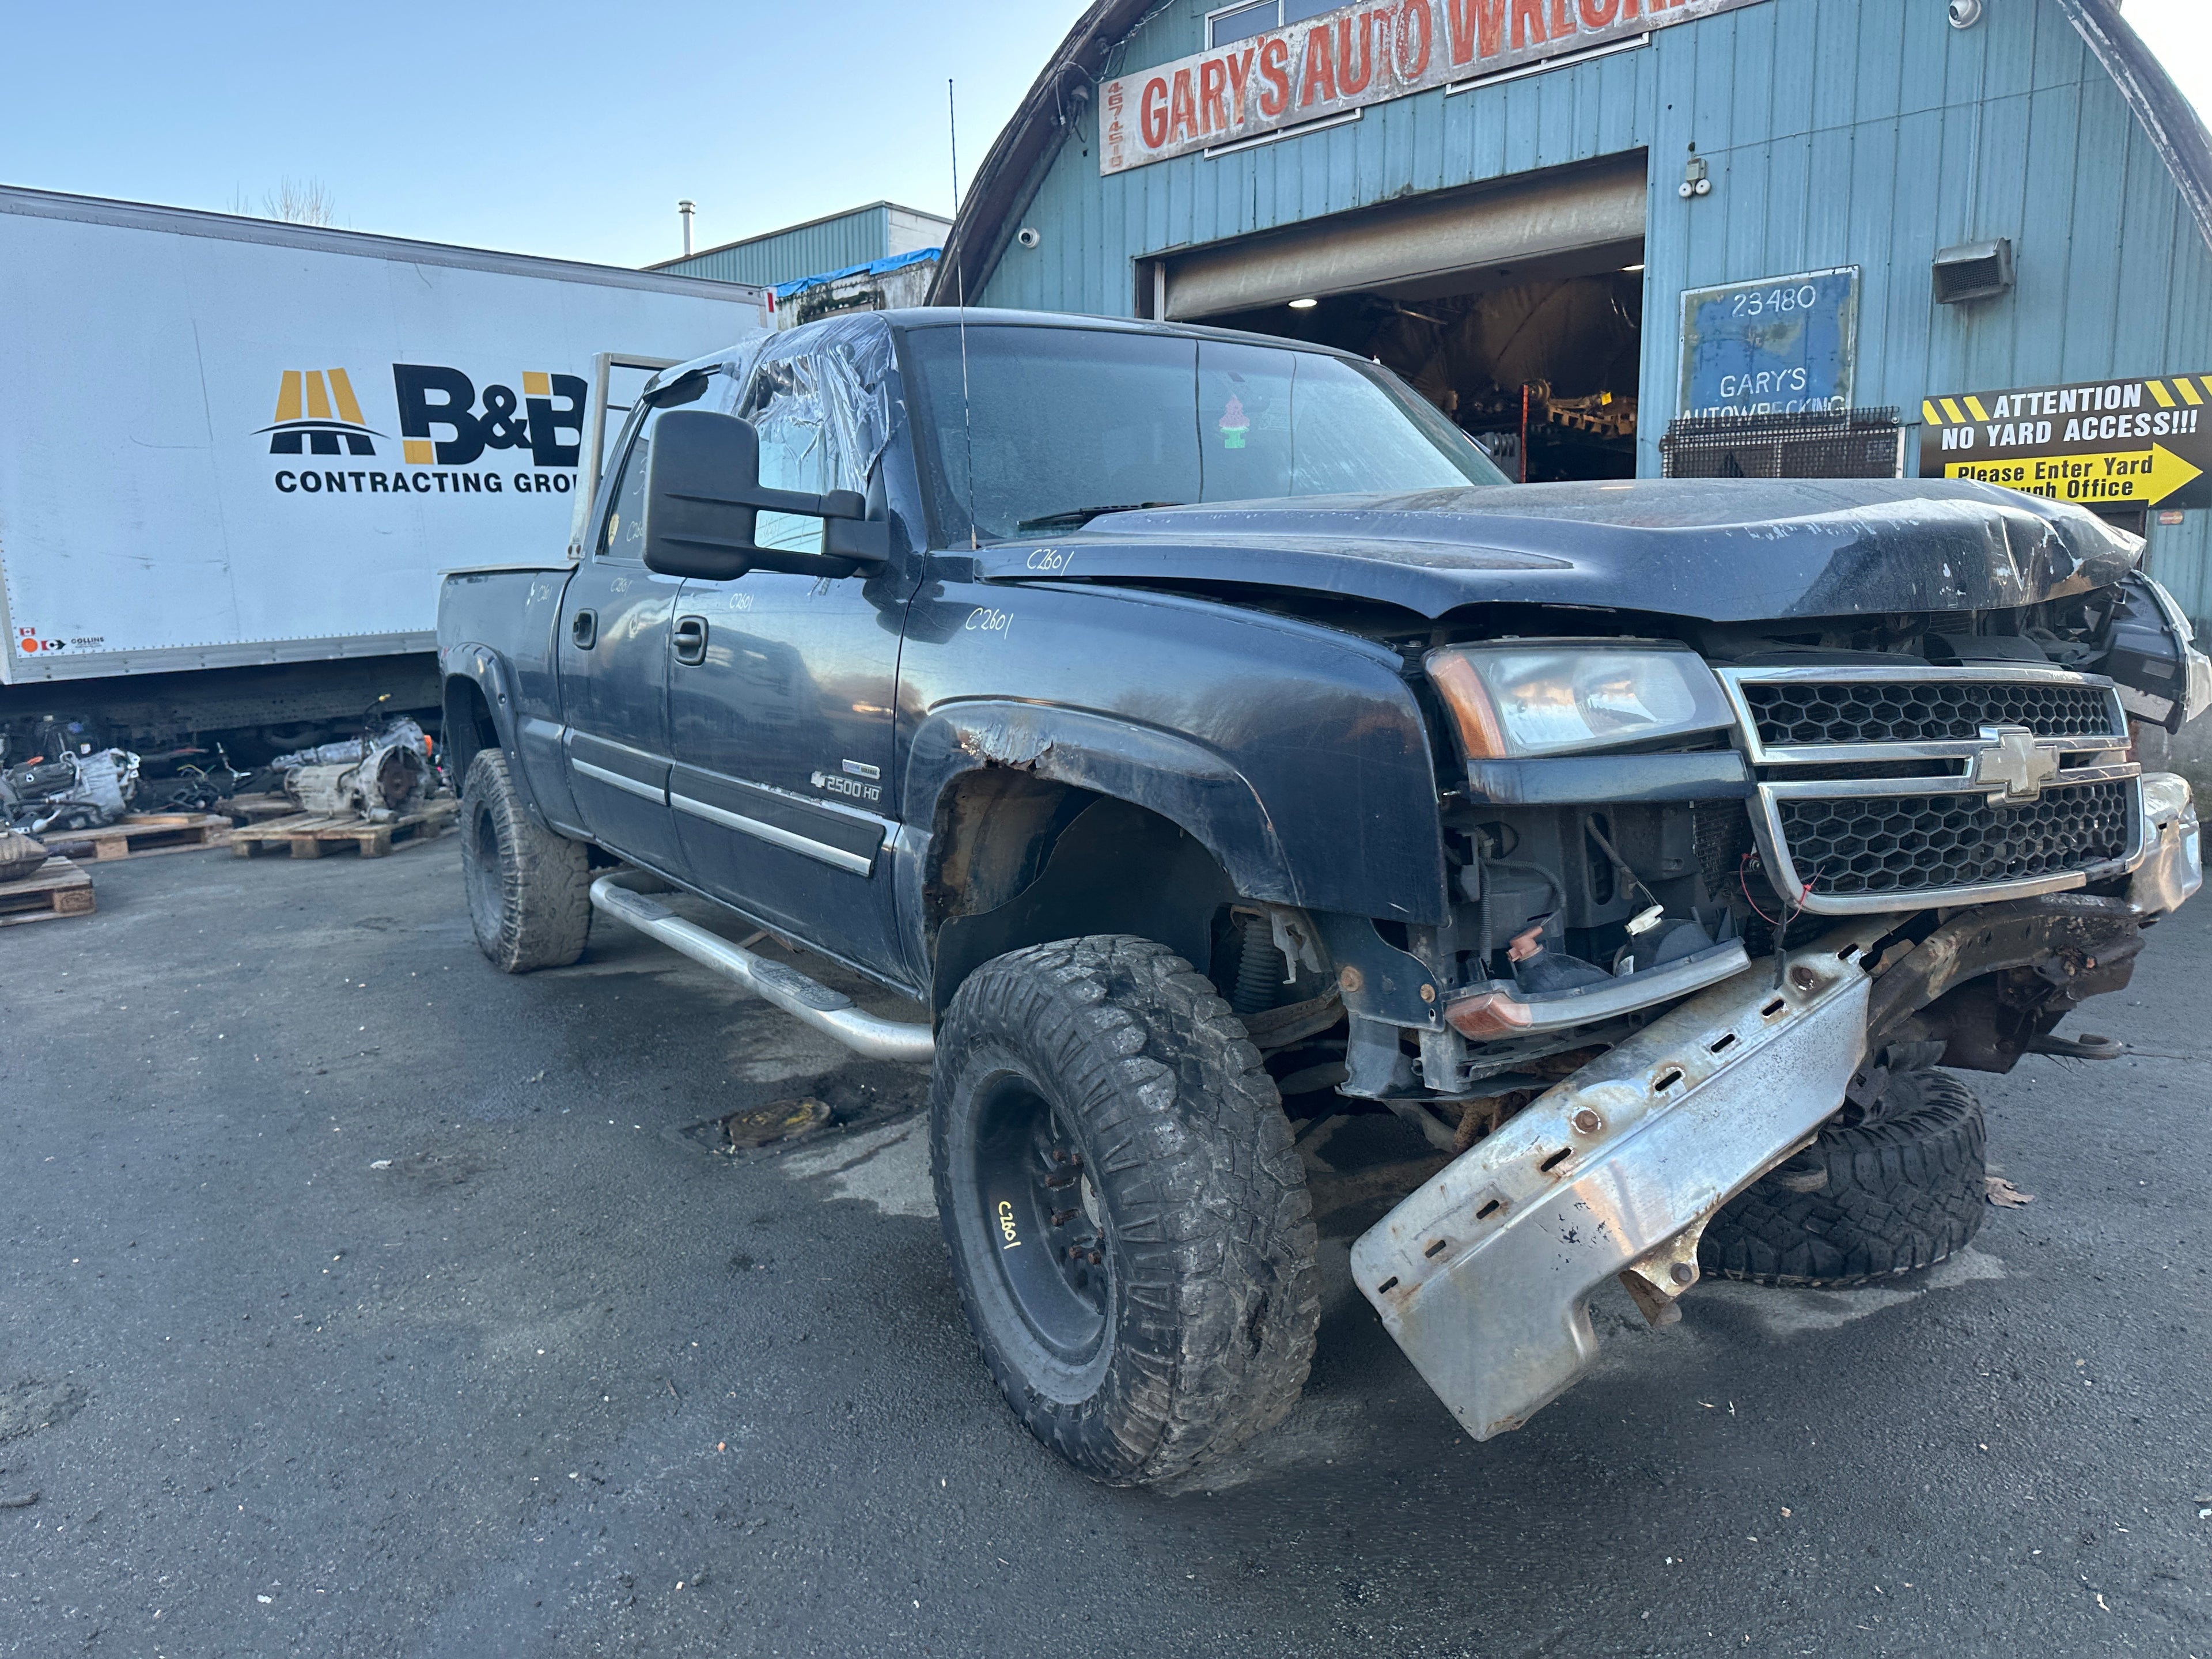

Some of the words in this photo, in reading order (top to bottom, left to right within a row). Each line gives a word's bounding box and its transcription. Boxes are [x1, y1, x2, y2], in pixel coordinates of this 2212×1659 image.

[1140, 36, 1289, 150] GARY'S
[1301, 0, 1432, 106] AUTO
[1732, 285, 1816, 317] 23480
[1720, 367, 1806, 397] GARY'S
[392, 363, 588, 467] B&B
[1993, 384, 2142, 419] ATTENTION
[1942, 426, 1974, 450] NO
[1987, 421, 2051, 447] YARD
[2063, 410, 2198, 442] ACCESS!!!
[275, 470, 503, 494] CONTRACTING
[1959, 467, 2024, 483] Please
[2035, 461, 2092, 480] Enter
[2105, 455, 2153, 476] Yard
[2067, 479, 2134, 499] Office
[1027, 548, 1074, 576] C2601
[729, 593, 755, 611] C2601
[965, 607, 1014, 640] C2601
[827, 776, 862, 798] 2500
[863, 786, 880, 801] HD
[998, 1200, 1021, 1249] C2601
